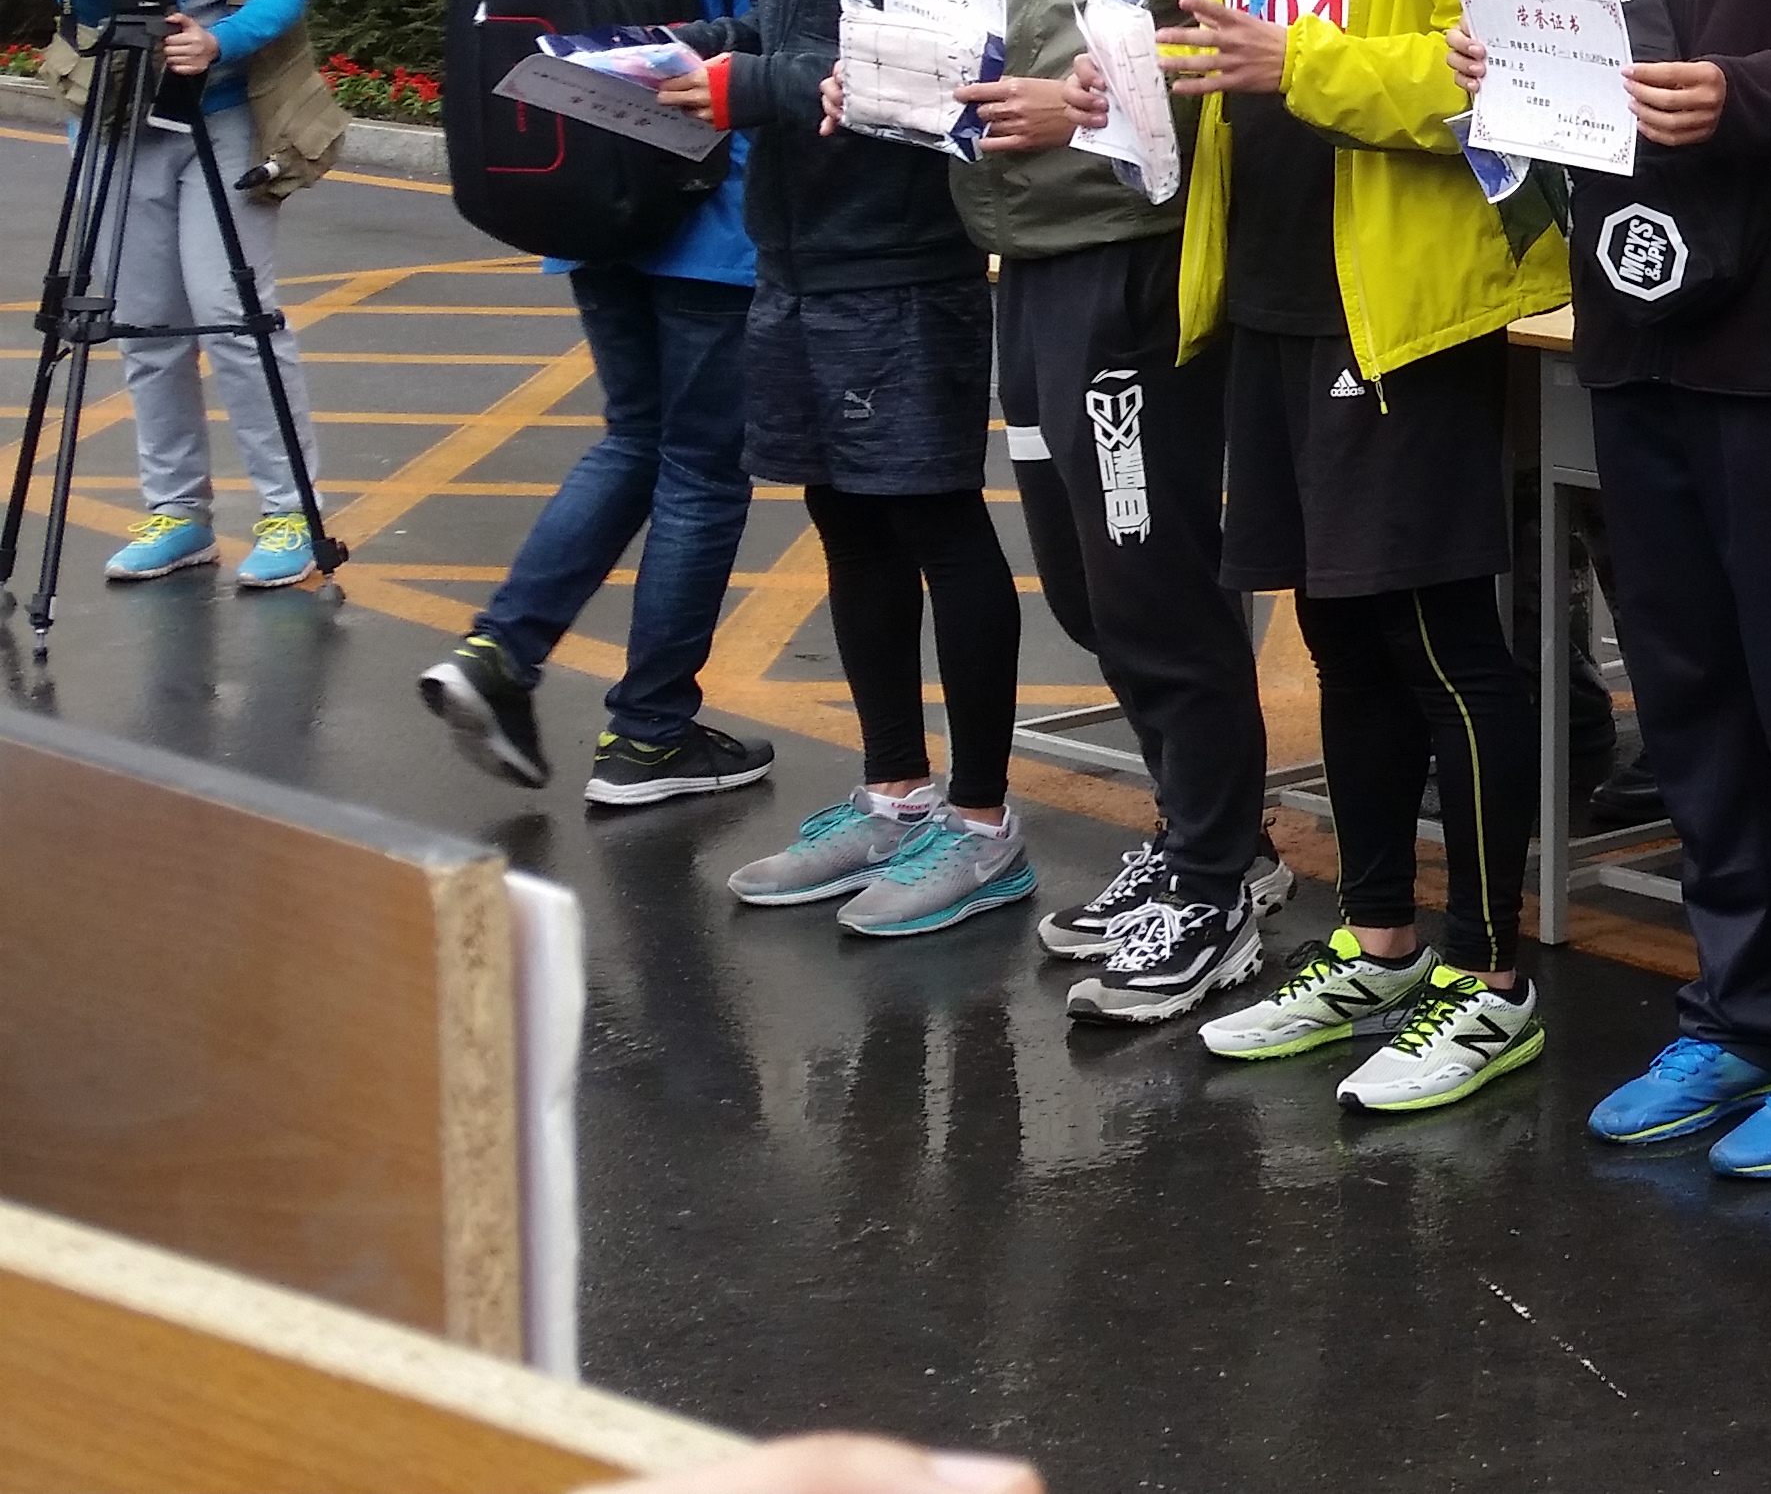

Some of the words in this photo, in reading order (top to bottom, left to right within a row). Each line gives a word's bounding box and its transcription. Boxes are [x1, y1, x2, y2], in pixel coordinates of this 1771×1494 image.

[1517, 6, 1580, 35] 荣誉证书
[1619, 219, 1653, 283] MCYS
